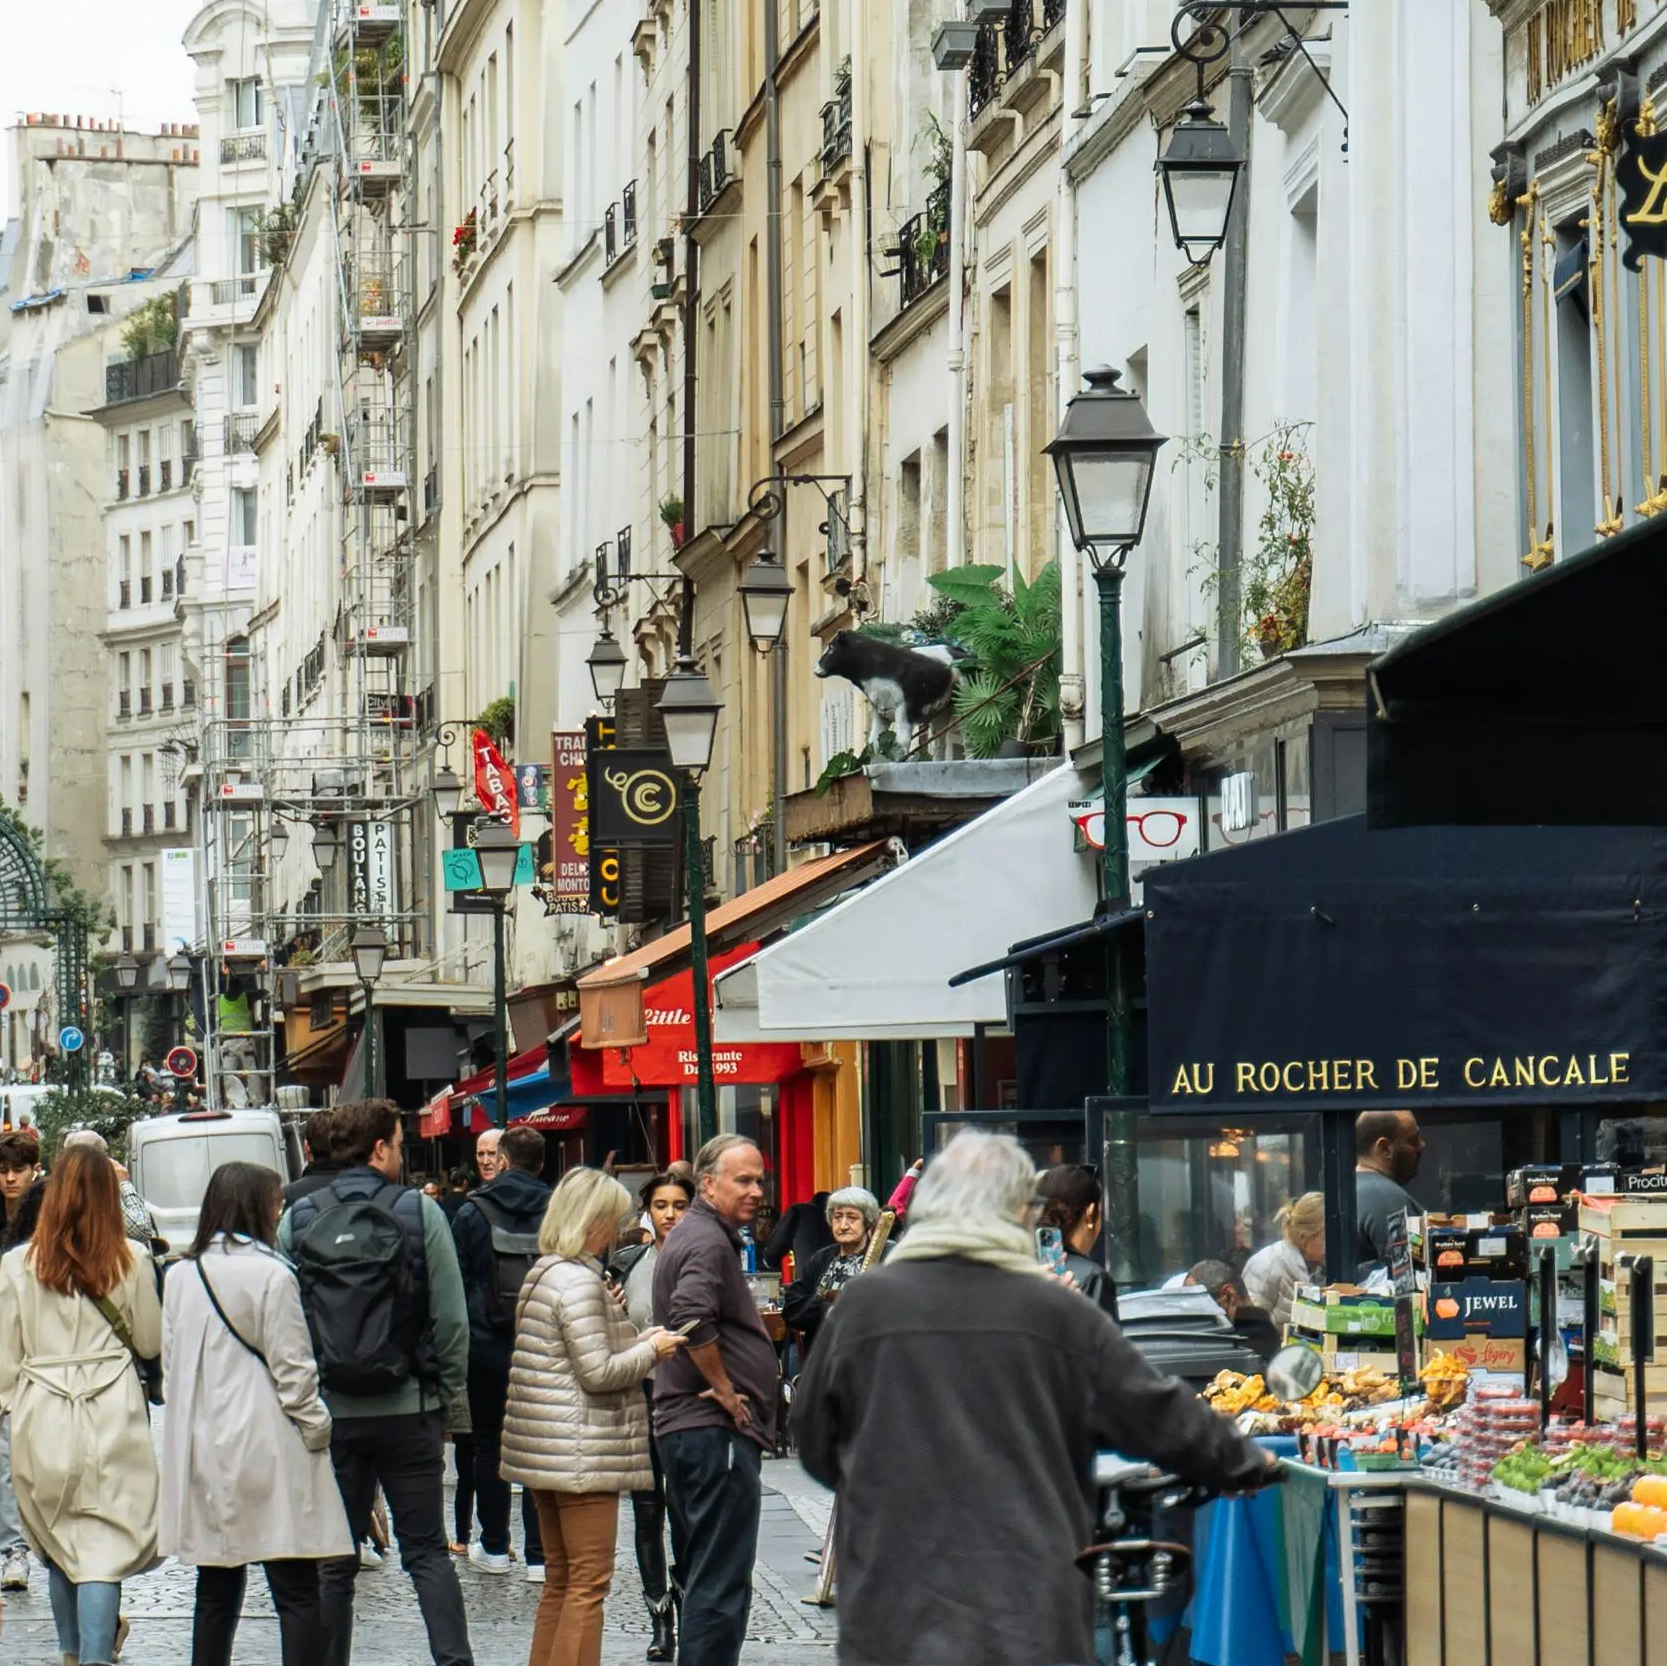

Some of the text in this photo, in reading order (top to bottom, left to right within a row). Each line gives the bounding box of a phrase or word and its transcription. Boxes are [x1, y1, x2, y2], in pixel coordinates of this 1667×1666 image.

[478, 746, 513, 825] TABAC
[678, 1050, 742, 1063] Risrante
[1172, 1053, 1630, 1094] AU ROCHER DE CANCALE
[1464, 1295, 1518, 1318] JEWEL
